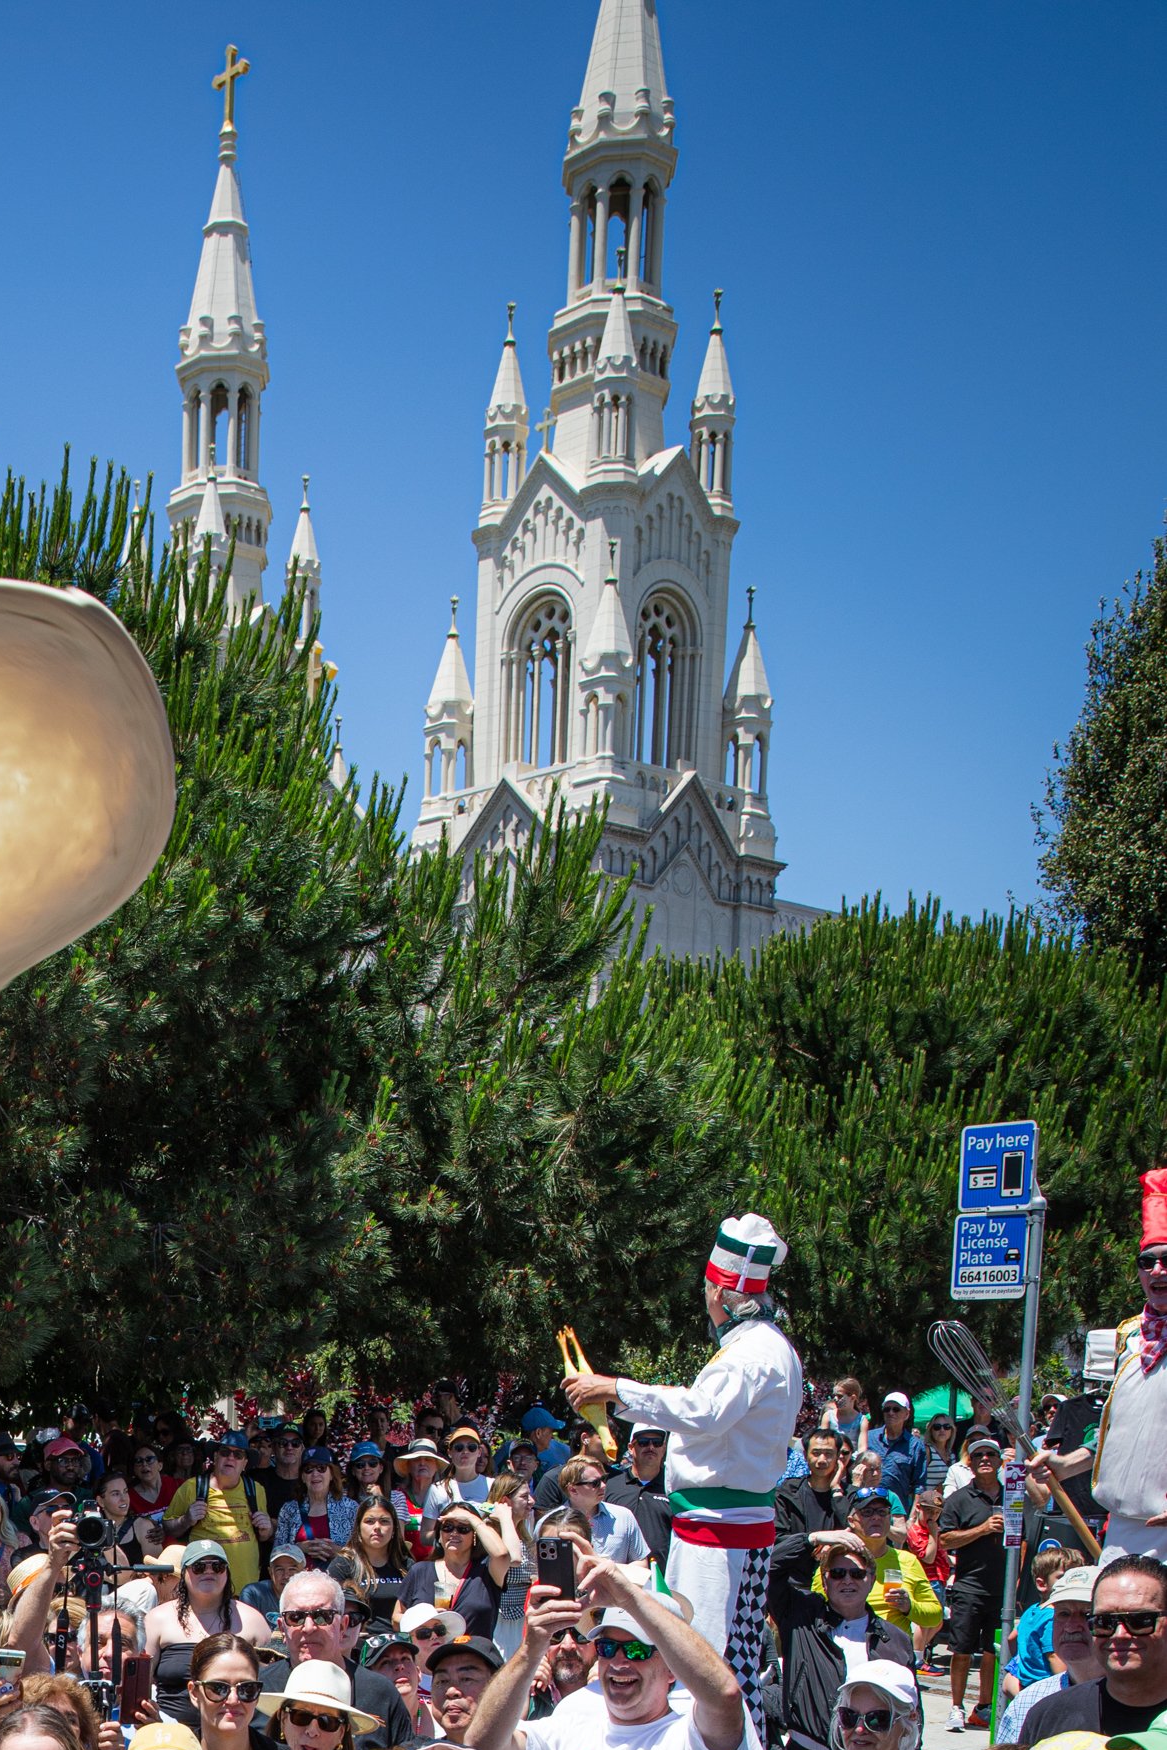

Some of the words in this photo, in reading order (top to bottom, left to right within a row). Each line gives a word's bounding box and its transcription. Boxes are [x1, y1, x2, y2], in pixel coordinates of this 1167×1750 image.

[967, 1136, 994, 1153] Pay
[995, 1132, 1030, 1148] here
[961, 1221, 985, 1237] Pay
[988, 1219, 1006, 1236] by
[960, 1236, 1009, 1250] License
[959, 1250, 993, 1265] Plate
[960, 1269, 1018, 1284] 66416003
[996, 1287, 1022, 1295] paystation
[1007, 1482, 1016, 1490] NO
